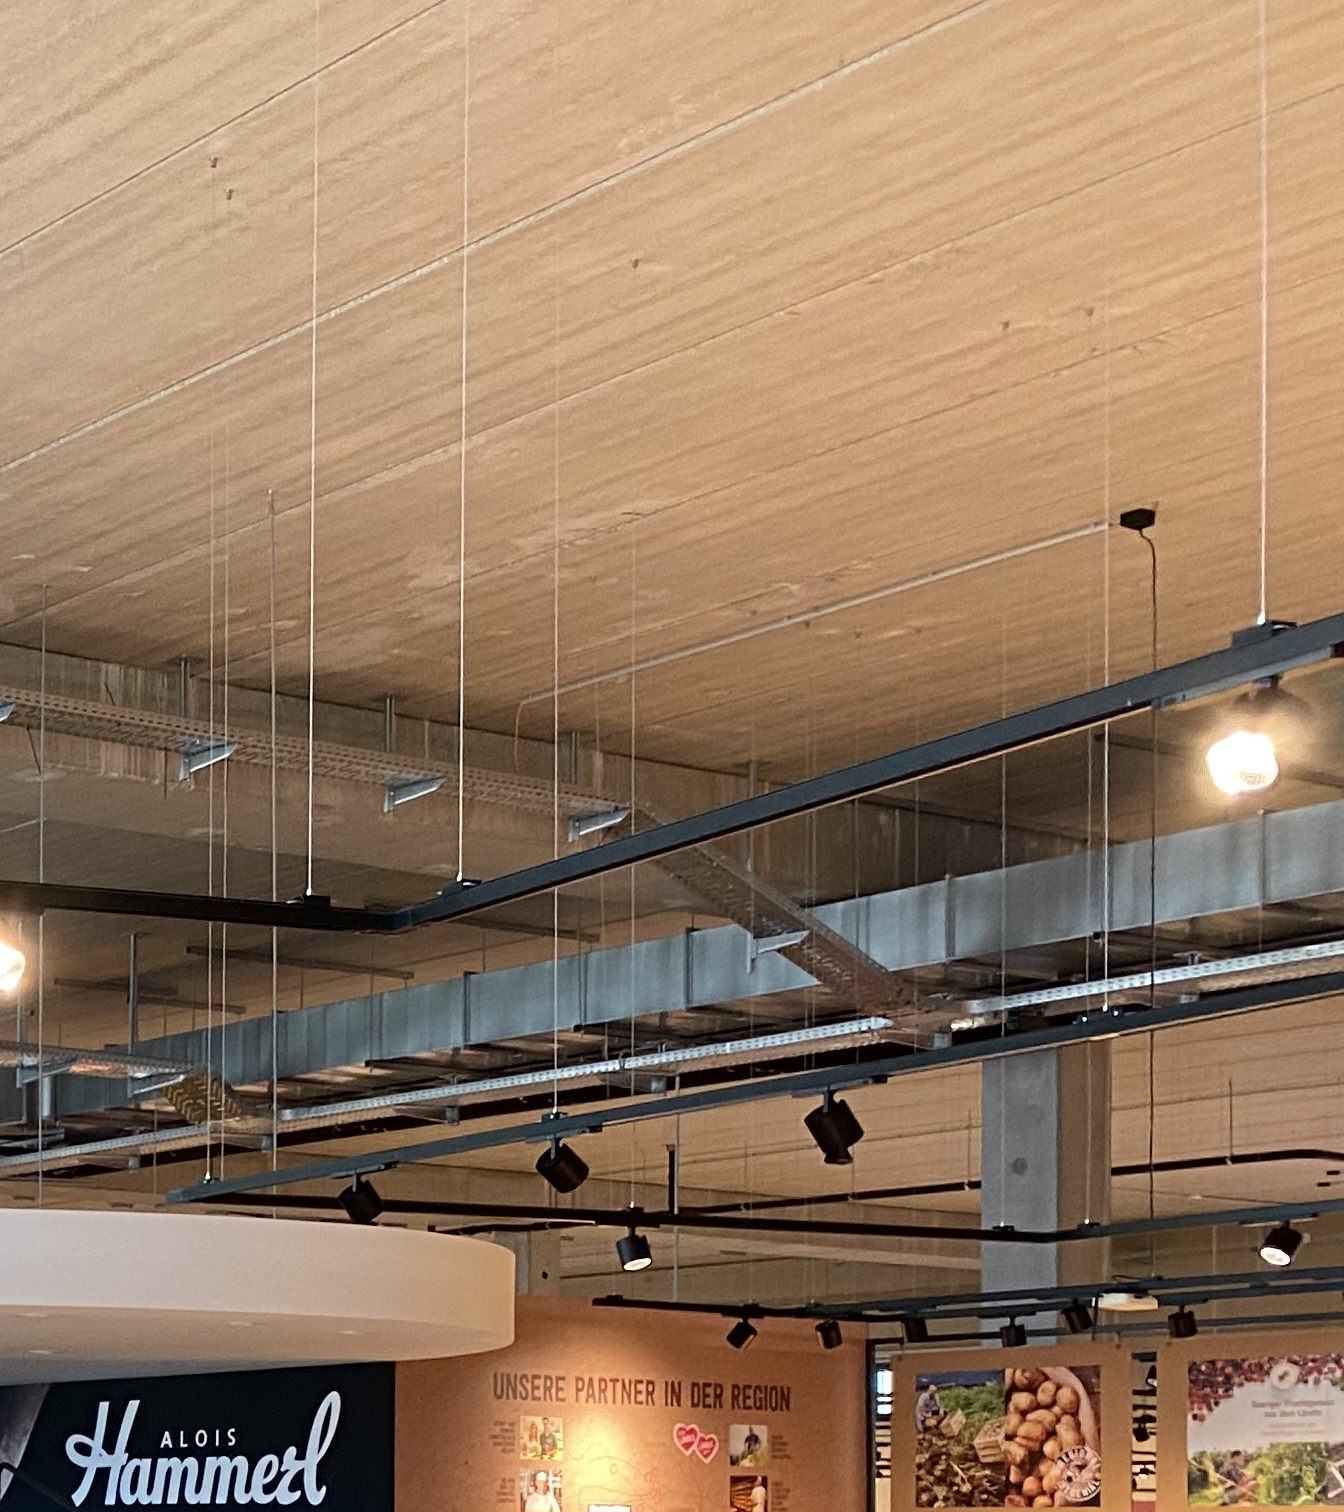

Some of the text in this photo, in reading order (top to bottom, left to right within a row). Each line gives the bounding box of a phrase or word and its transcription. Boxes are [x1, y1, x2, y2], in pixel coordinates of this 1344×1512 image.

[493, 1371, 791, 1412] UNSERE PARTNER IN DER REGION
[65, 1390, 341, 1507] Hammerl
[160, 1428, 237, 1449] ALOIS
